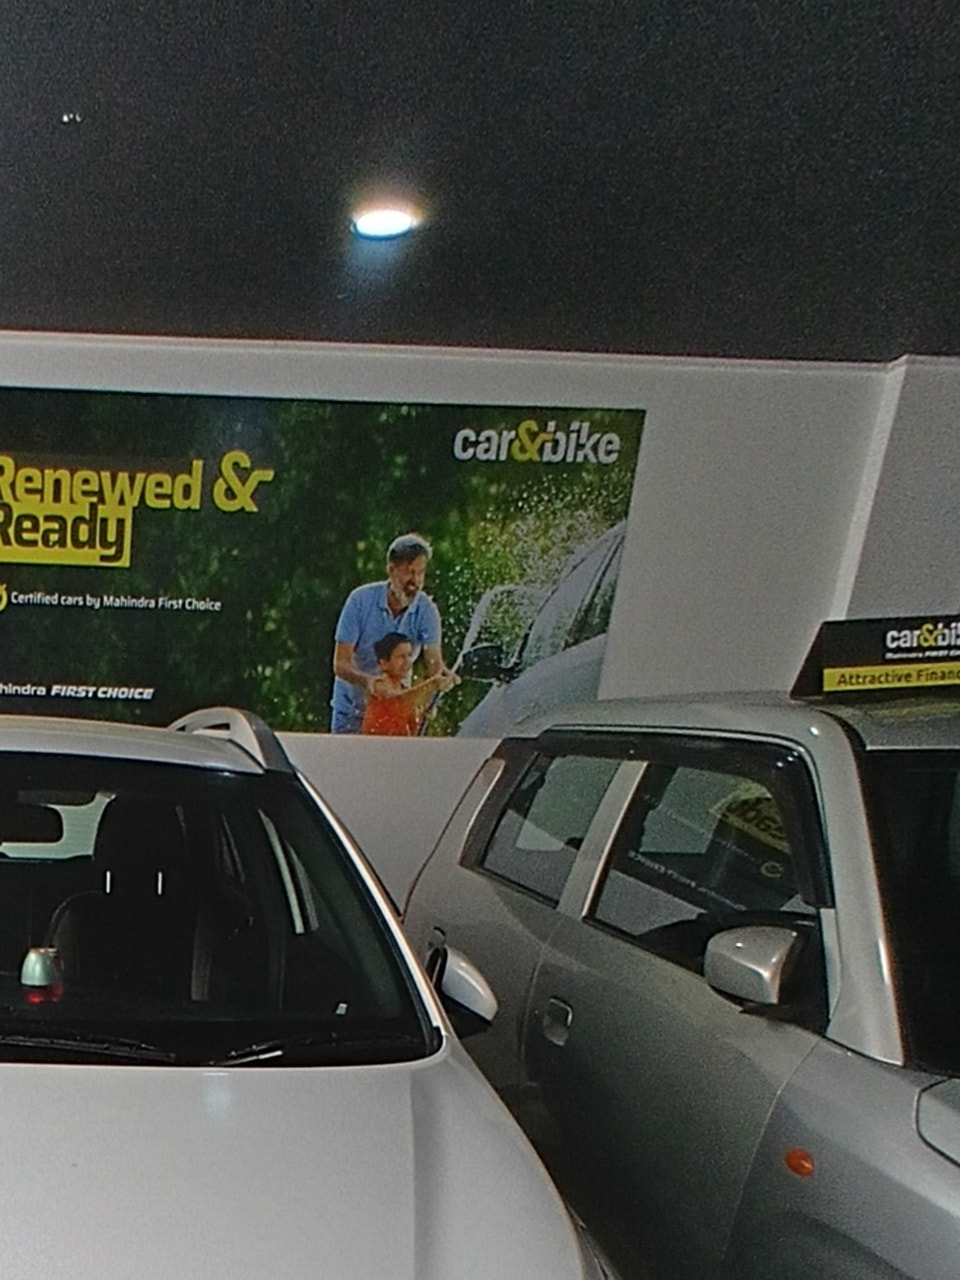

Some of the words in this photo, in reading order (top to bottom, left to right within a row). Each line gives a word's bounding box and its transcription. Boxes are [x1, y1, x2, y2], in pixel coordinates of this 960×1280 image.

[453, 420, 621, 464] car&bike
[213, 450, 274, 512] &
[11, 591, 58, 605] Certified
[60, 595, 84, 606] cars
[86, 594, 101, 609] by
[103, 595, 156, 609] Mahindra
[158, 597, 183, 609] First
[184, 598, 221, 611] Choice
[837, 670, 912, 687] Attractive
[50, 684, 97, 698] FIRST
[97, 686, 155, 700] CHOICE
